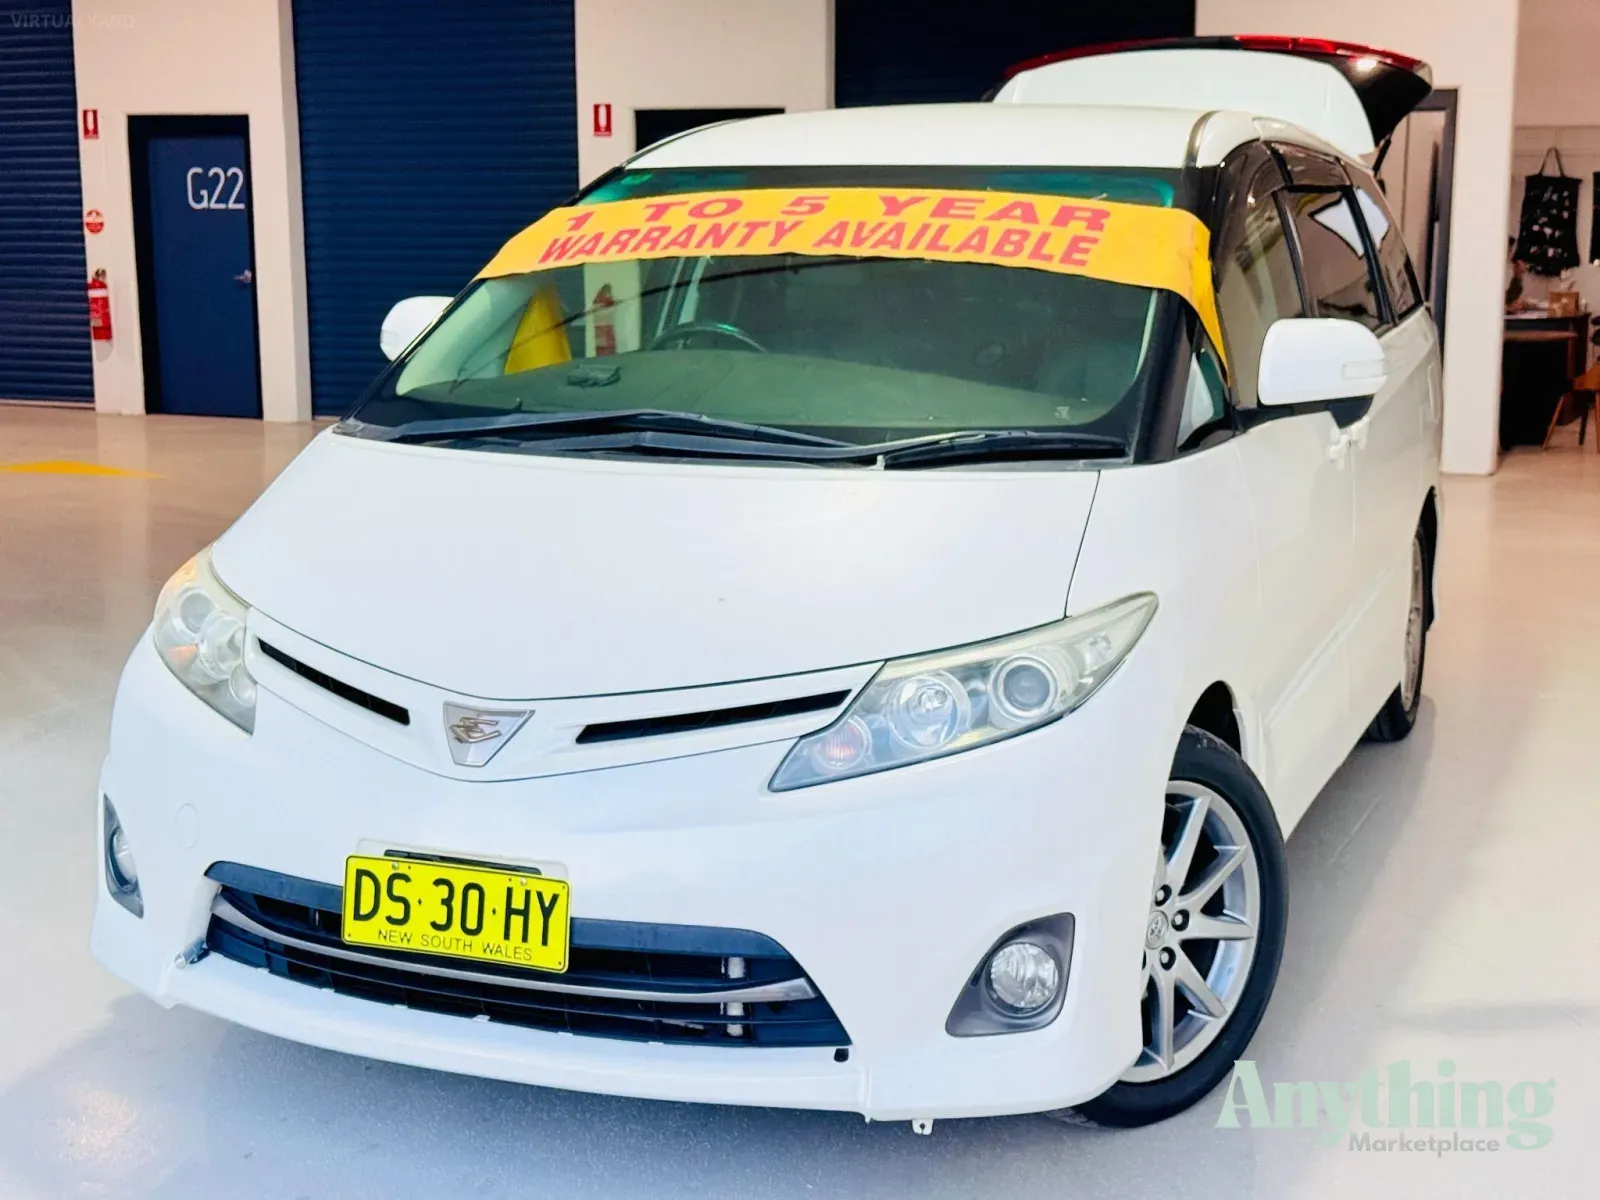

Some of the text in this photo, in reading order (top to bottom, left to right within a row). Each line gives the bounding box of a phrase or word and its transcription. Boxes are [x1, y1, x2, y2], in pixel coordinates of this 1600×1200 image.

[187, 166, 245, 210] G22
[567, 195, 1111, 232] 1 TO 5 YEAR
[538, 220, 1100, 266] WARRANTY AVAILABLE
[378, 929, 532, 961] NEW SOUTH WALES
